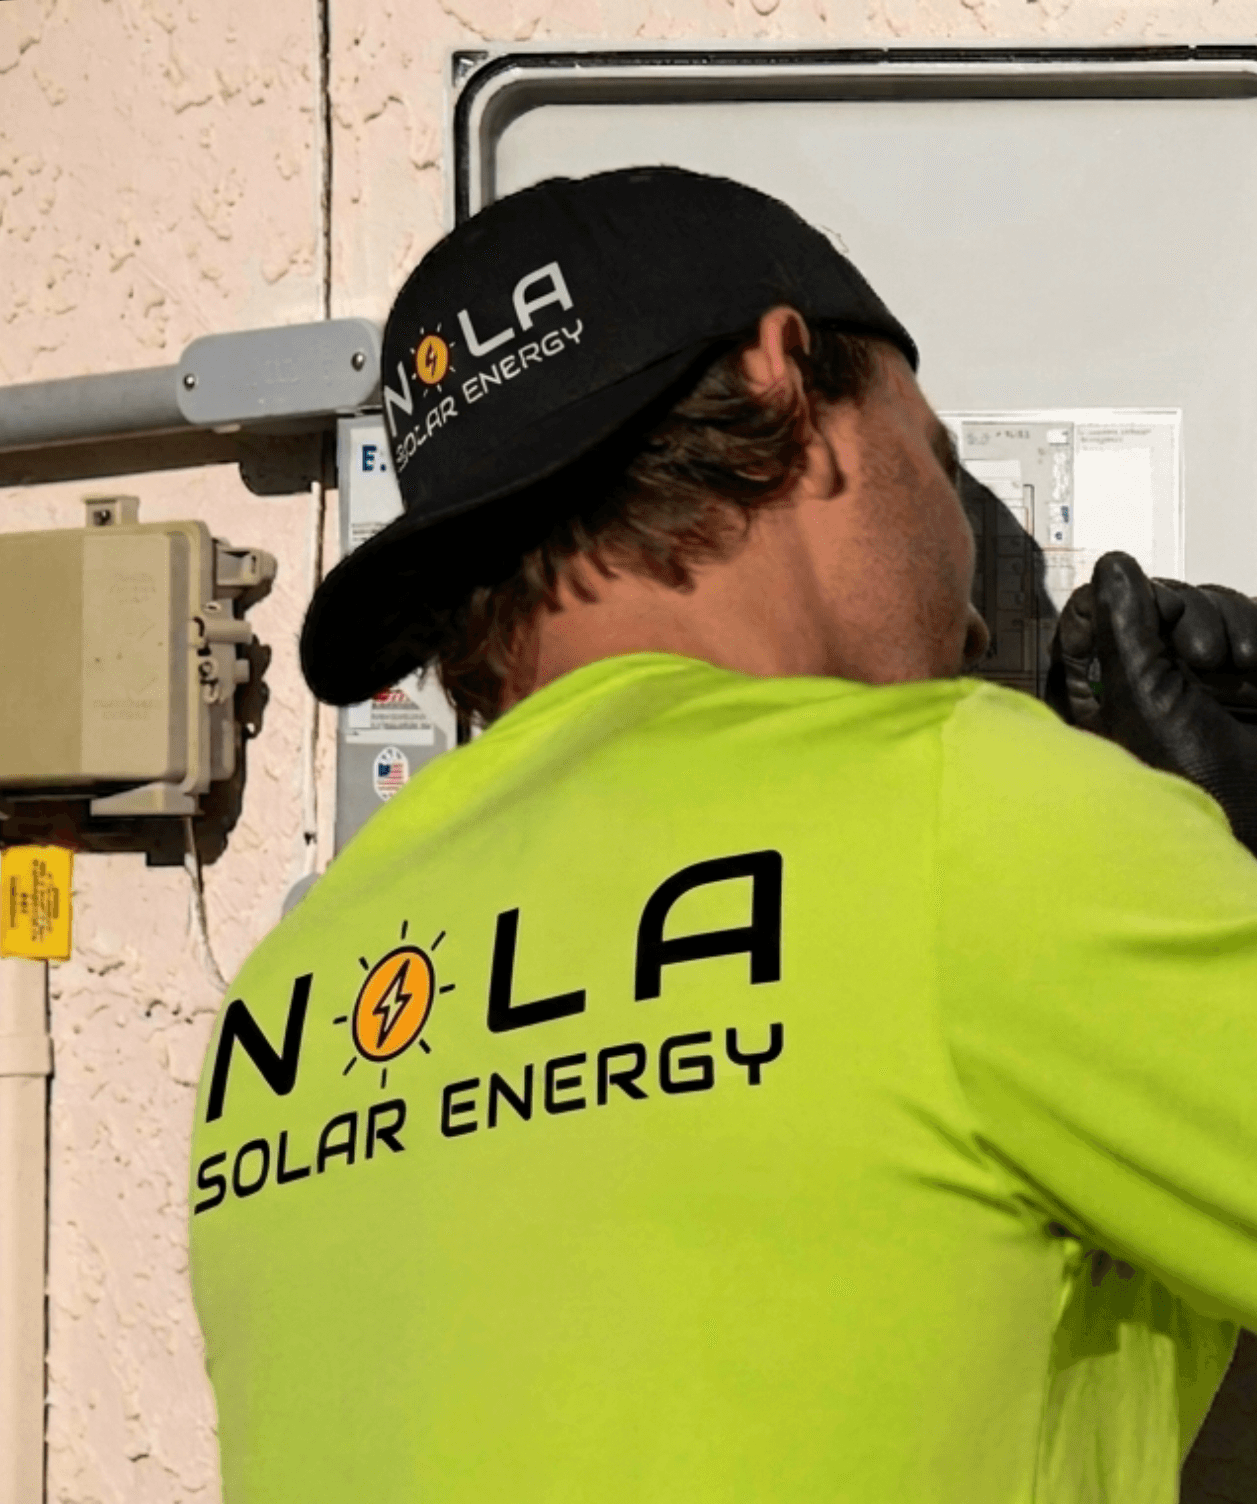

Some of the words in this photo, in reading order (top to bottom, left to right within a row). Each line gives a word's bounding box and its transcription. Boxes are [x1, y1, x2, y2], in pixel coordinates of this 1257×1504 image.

[396, 396, 459, 473] SOLAR
[462, 318, 583, 404] ENERGY
[205, 849, 783, 1124] NOLA
[194, 1098, 406, 1216] SOLAR
[441, 1022, 784, 1138] ENERGY
